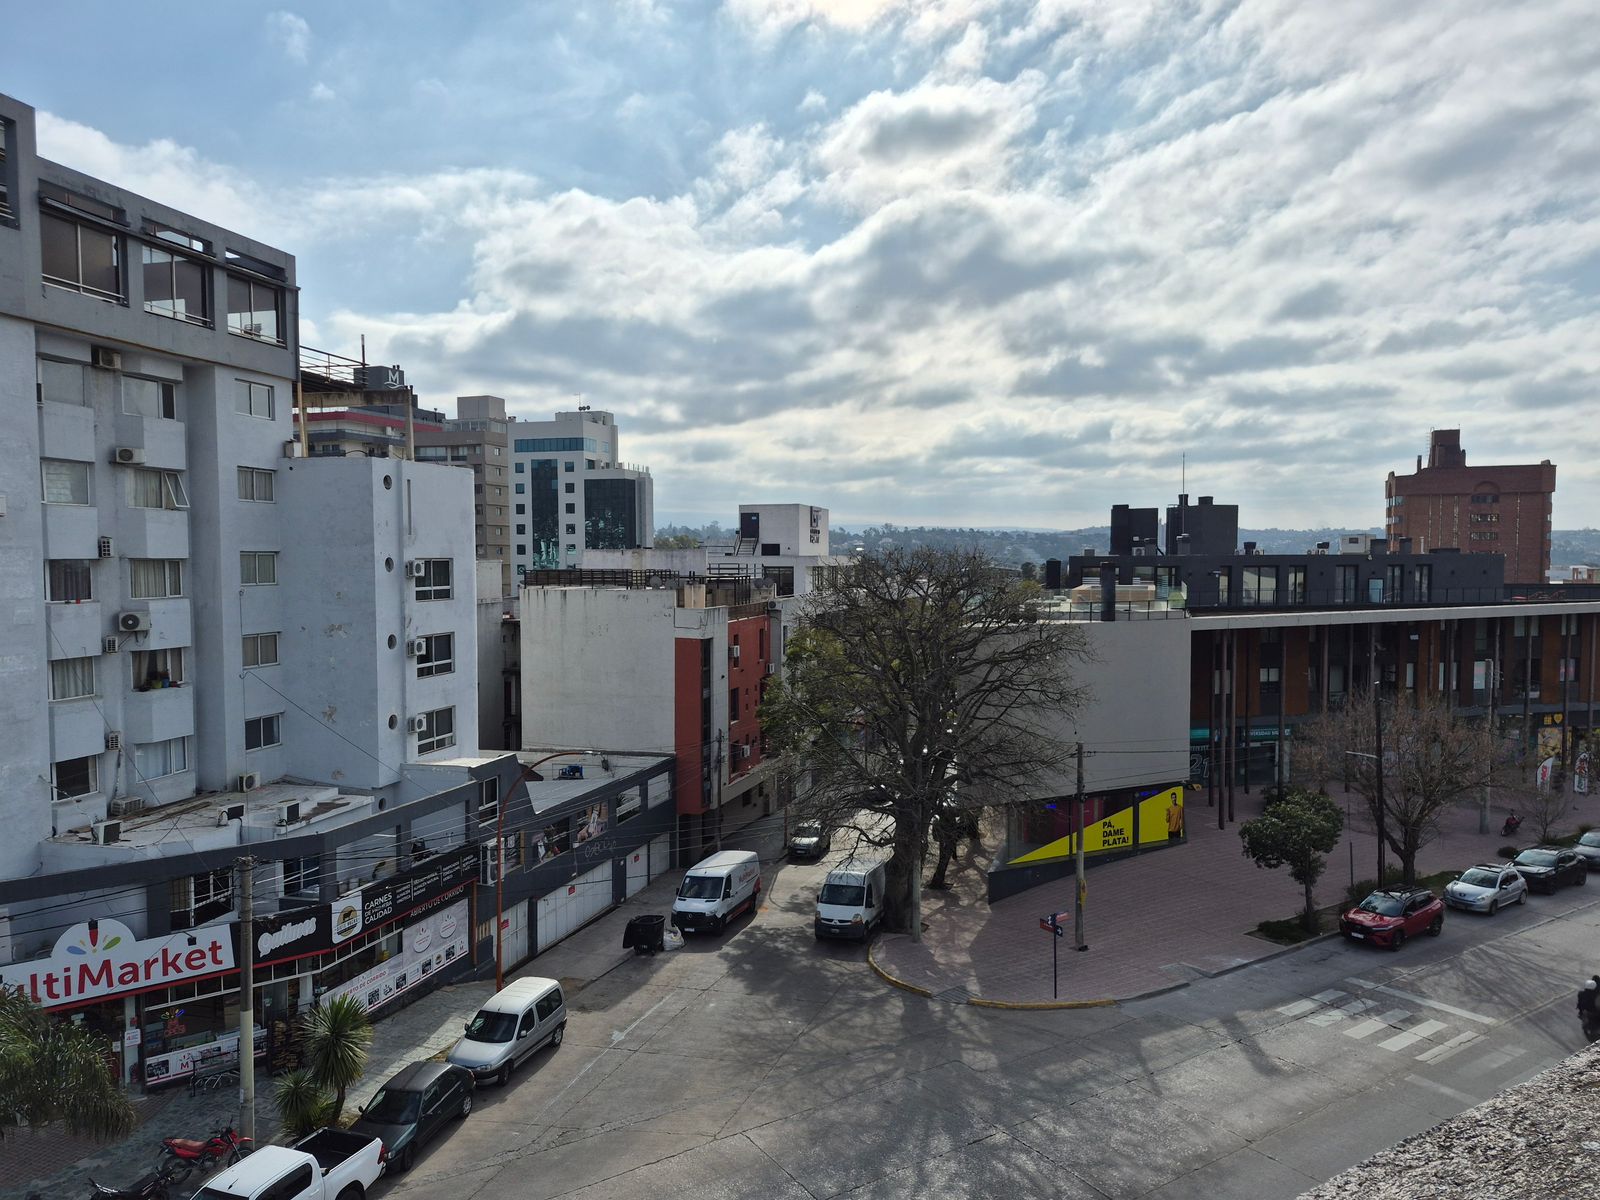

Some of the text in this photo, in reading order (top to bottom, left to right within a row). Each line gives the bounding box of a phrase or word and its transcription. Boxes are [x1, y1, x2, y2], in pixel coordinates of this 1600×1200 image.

[1102, 828, 1125, 838] DAME
[1102, 836, 1129, 847] PLATA!
[364, 892, 392, 910] CARNES
[364, 906, 392, 925] CALIDAD
[257, 916, 317, 958] Quilmes
[16, 940, 223, 1004] ltiMarket
